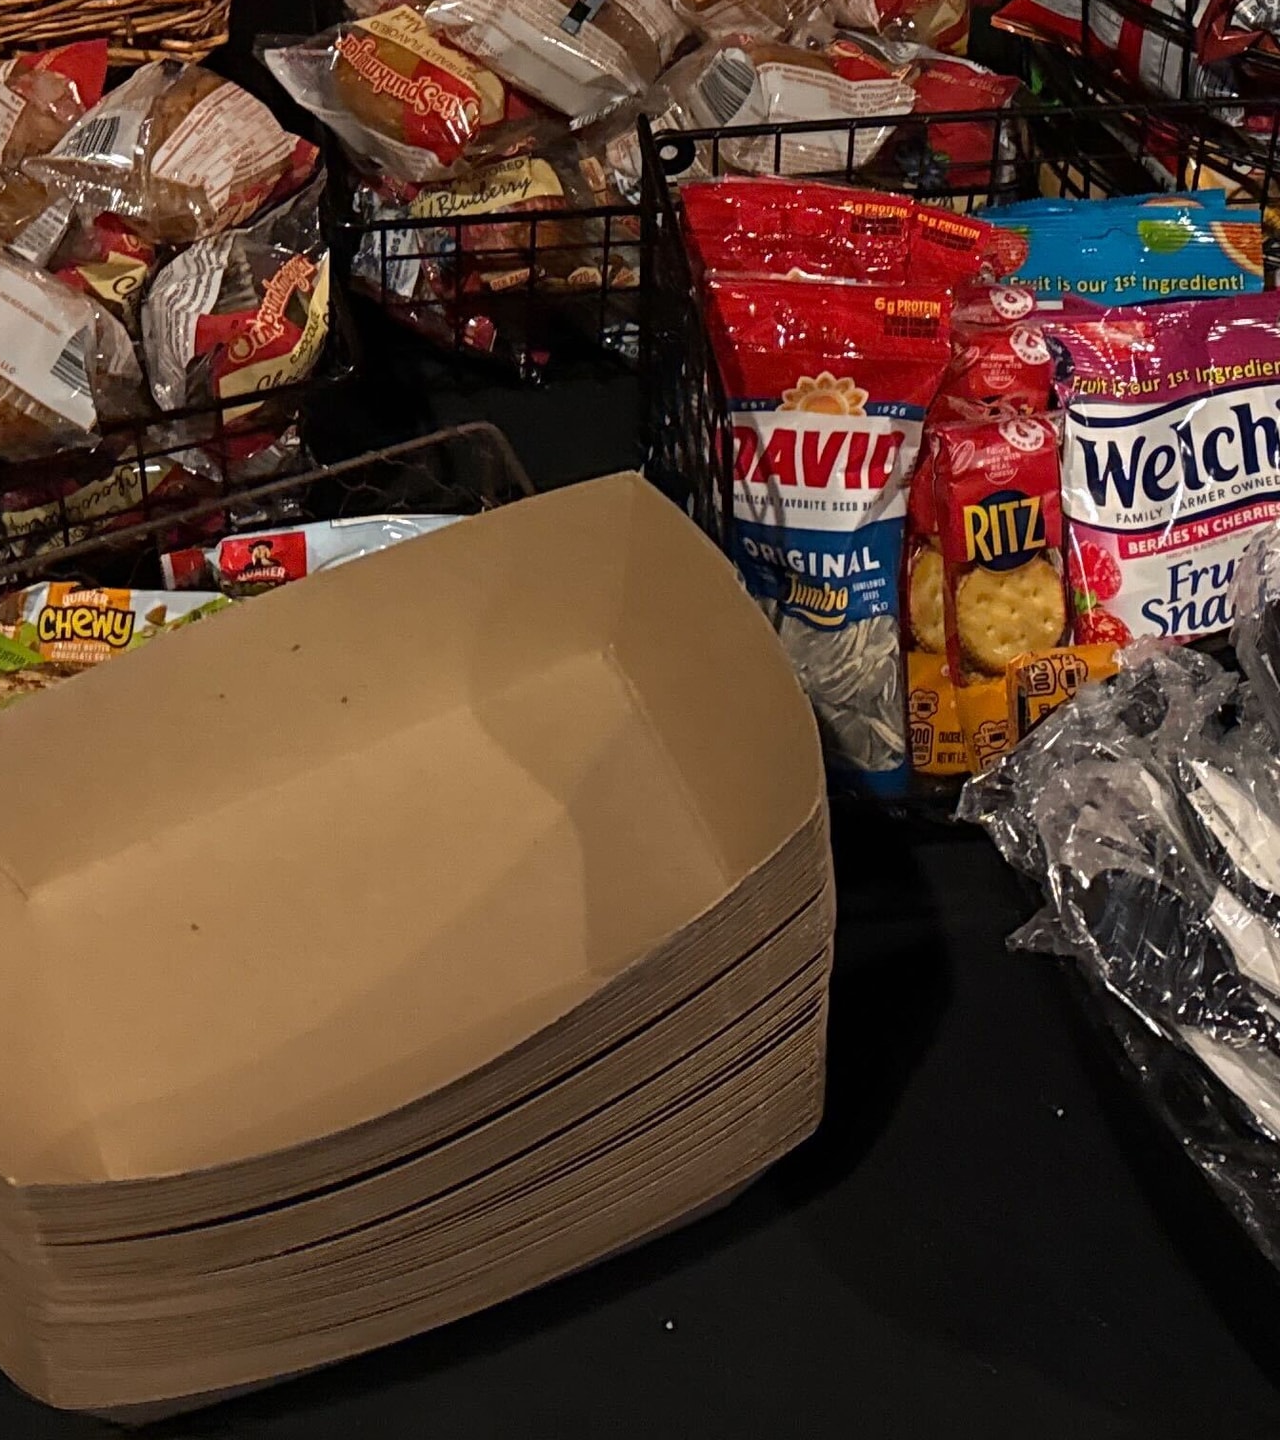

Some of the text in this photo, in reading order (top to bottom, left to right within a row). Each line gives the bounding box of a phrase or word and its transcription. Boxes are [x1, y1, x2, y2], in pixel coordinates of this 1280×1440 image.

[338, 33, 443, 116] Spunkmeyer
[435, 176, 532, 220] Blueberry
[864, 202, 909, 217] PROTEIN
[938, 217, 982, 240] PROTEIN
[1058, 274, 1070, 292] is
[1077, 277, 1108, 293] our
[1114, 273, 1137, 292] 1st
[1142, 273, 1246, 294] Ingredient!
[897, 300, 942, 316] PROTEIN
[1072, 374, 1107, 393] Fruit
[1129, 377, 1161, 396] our
[1167, 368, 1192, 389] 1st
[716, 426, 906, 489] DAVID
[778, 497, 827, 511] FAVORITE
[832, 501, 859, 512] SEED
[1115, 506, 1164, 525] FAMILY
[1170, 488, 1227, 515] ARMER
[963, 496, 1046, 562] RITZ
[1127, 528, 1190, 555] BERRIES
[237, 566, 286, 581] QUAKER
[742, 536, 882, 579] ORIGINAL
[783, 572, 850, 612] Jumbo
[1167, 558, 1236, 604] Fru
[1141, 593, 1235, 638] Sna
[1031, 662, 1051, 691] 200
